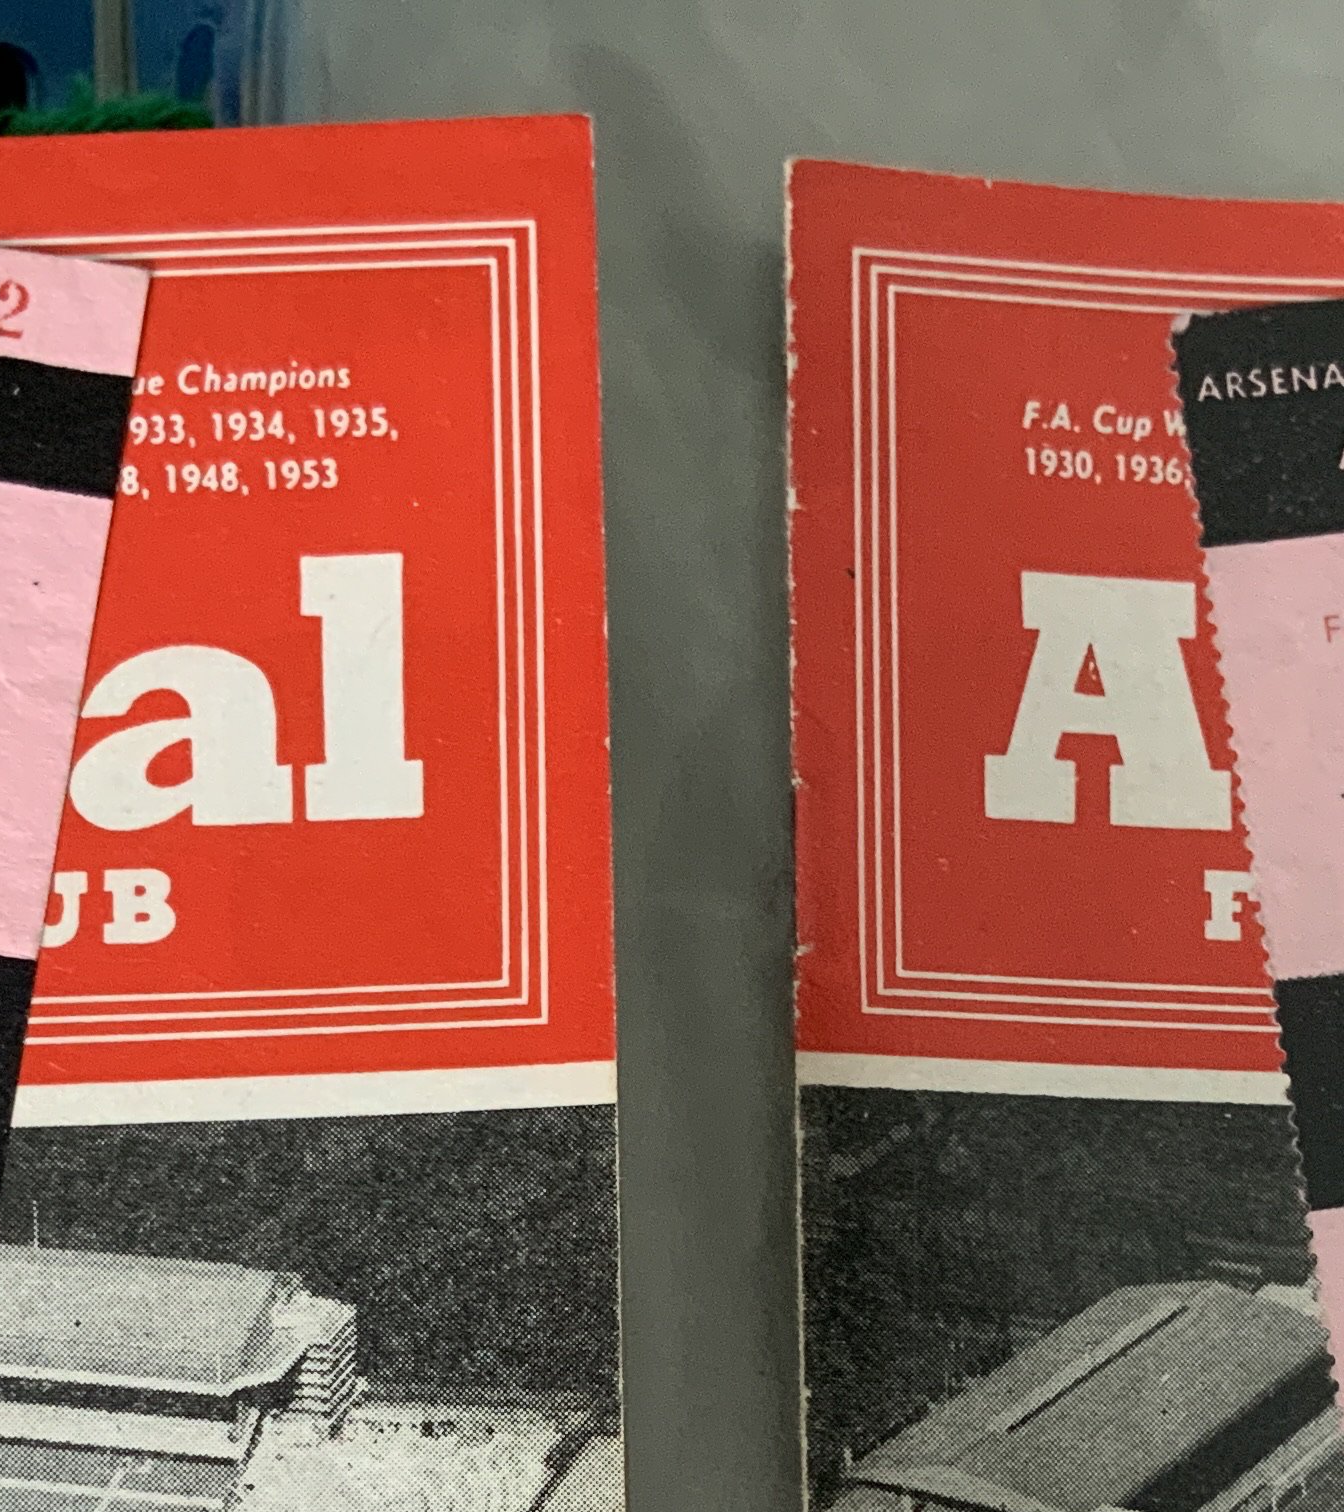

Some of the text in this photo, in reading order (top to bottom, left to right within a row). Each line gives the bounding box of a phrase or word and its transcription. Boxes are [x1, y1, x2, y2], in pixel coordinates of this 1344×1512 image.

[177, 361, 352, 397] Champions
[129, 406, 398, 448] 933, 1934, 1935,
[1022, 400, 1080, 433] F.A.
[1093, 404, 1152, 442] Cup
[164, 461, 249, 496] 1948,
[264, 457, 339, 490] 1953
[1025, 447, 1192, 490] 1930, 1936,
